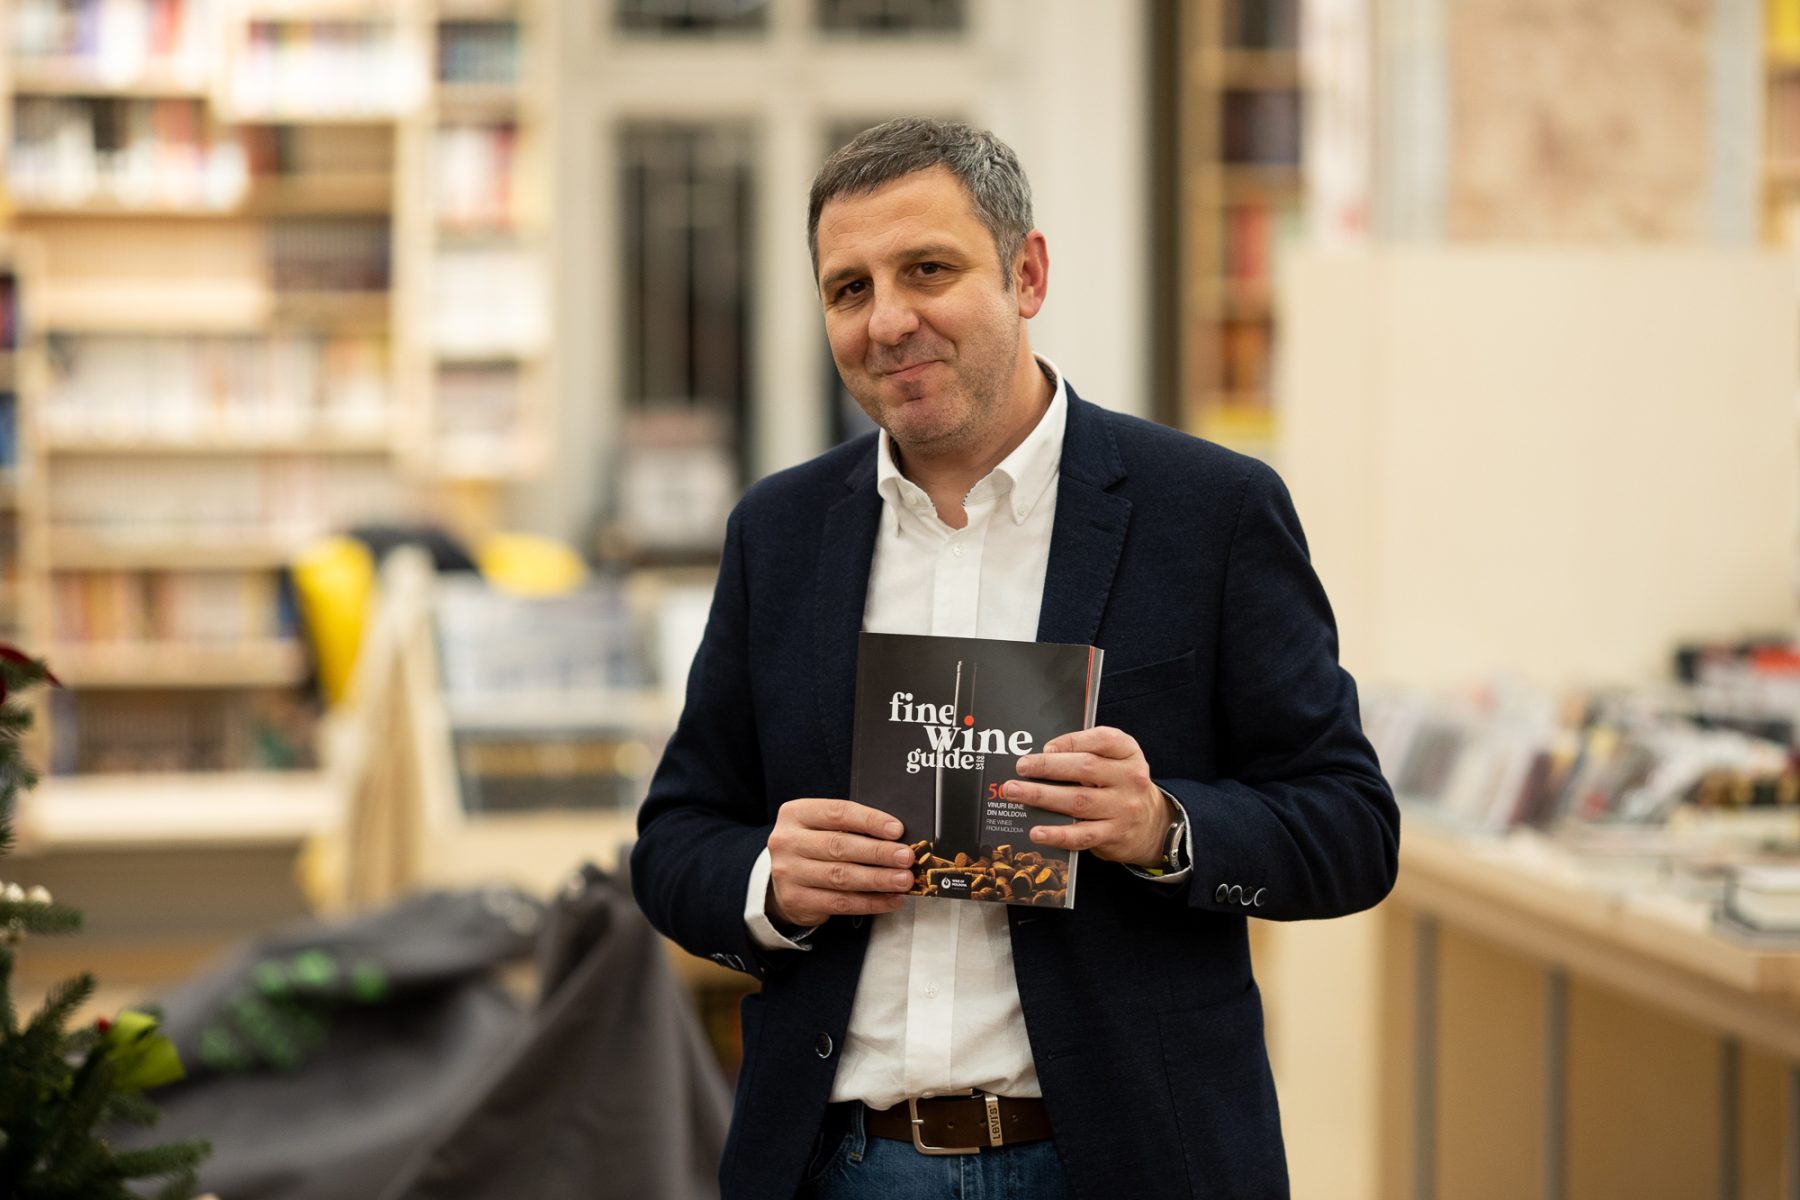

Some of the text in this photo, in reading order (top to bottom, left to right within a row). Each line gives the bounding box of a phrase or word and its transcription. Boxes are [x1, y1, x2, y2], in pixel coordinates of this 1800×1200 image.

[888, 691, 955, 725] fine
[923, 714, 1033, 756] wine
[906, 747, 974, 774] guide
[987, 801, 1007, 809] VINURI
[998, 810, 1027, 818] MOLDOVA
